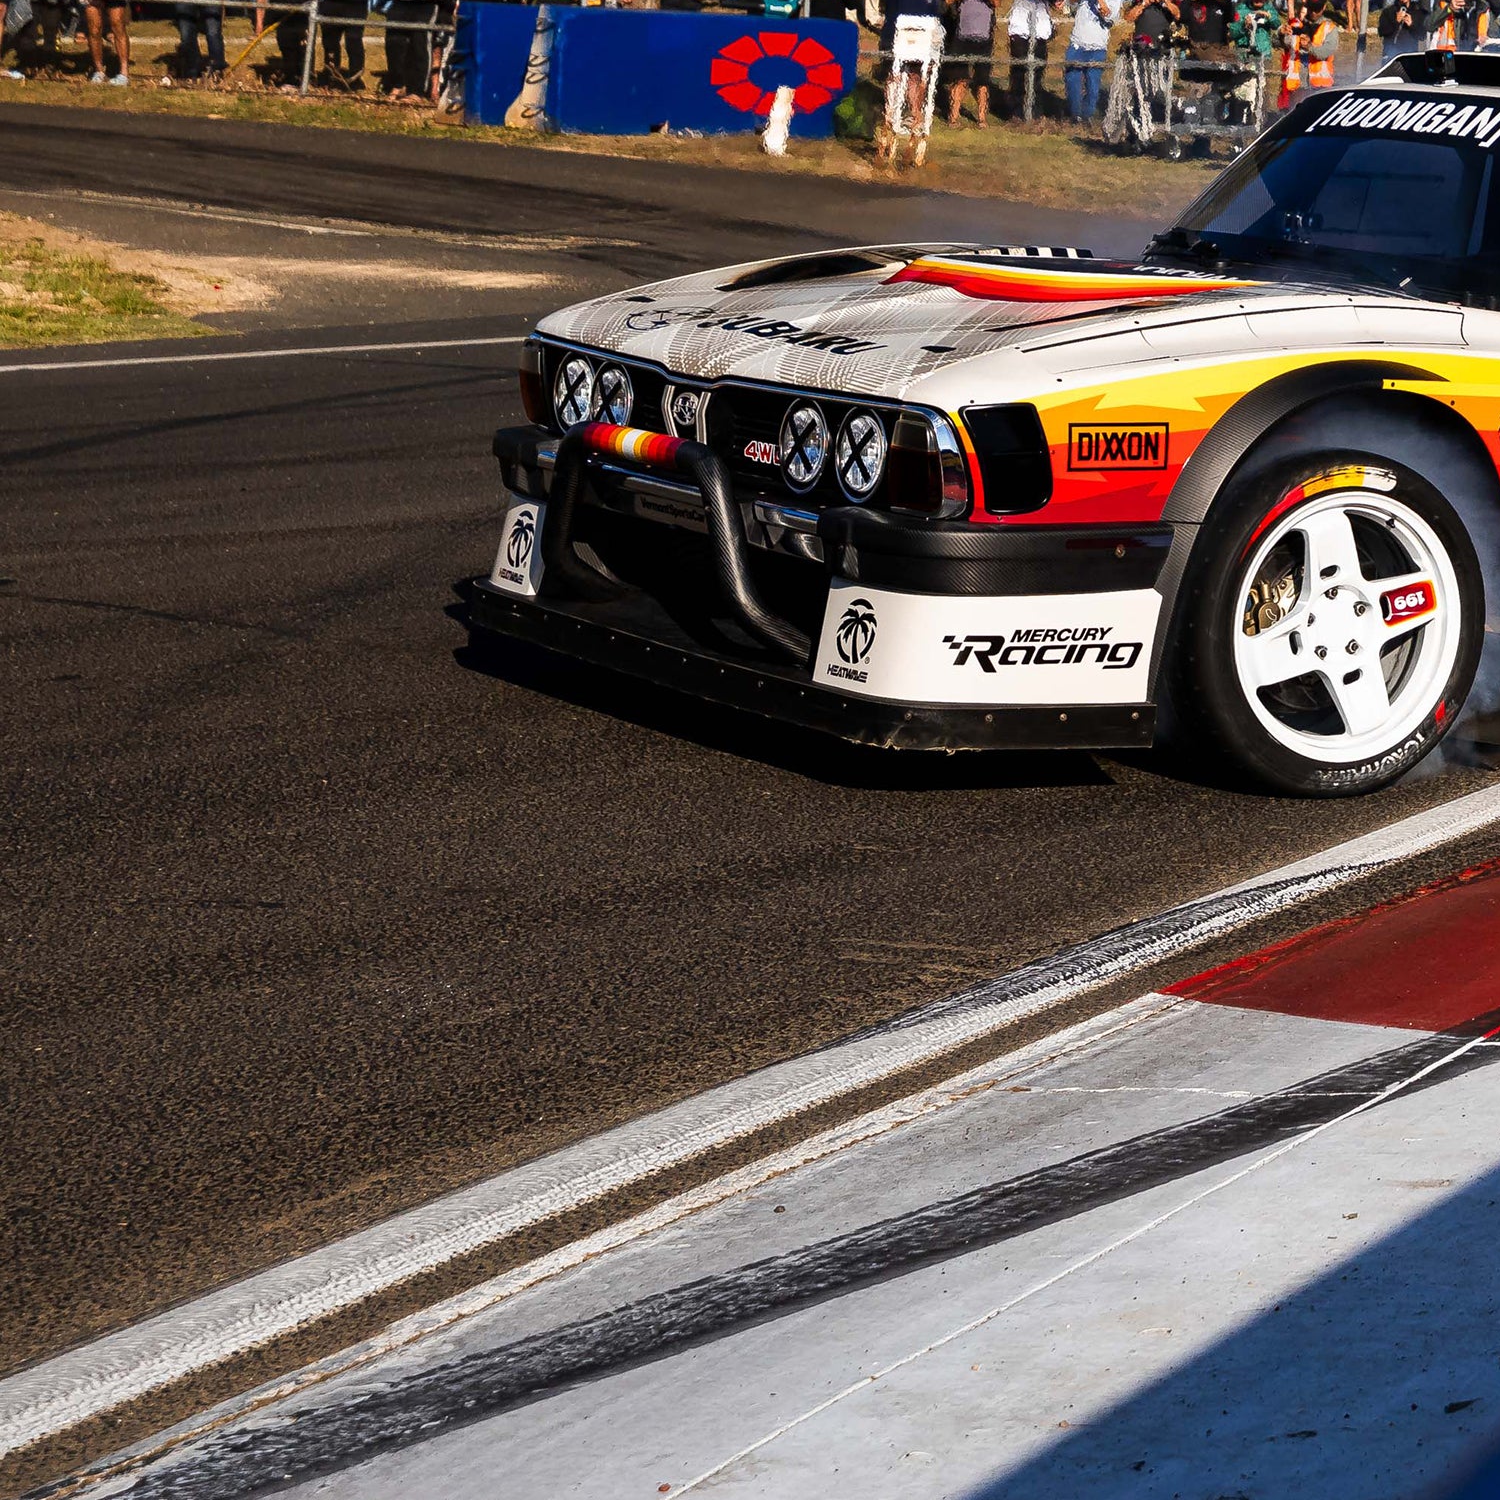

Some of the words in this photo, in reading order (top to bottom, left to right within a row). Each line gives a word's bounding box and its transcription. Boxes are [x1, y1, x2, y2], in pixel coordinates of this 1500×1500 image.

[697, 315, 888, 355] SUBARU
[1077, 432, 1159, 461] DIXXON
[1394, 591, 1426, 610] 199
[1010, 627, 1113, 643] MERCURY
[943, 635, 1143, 673] Racing
